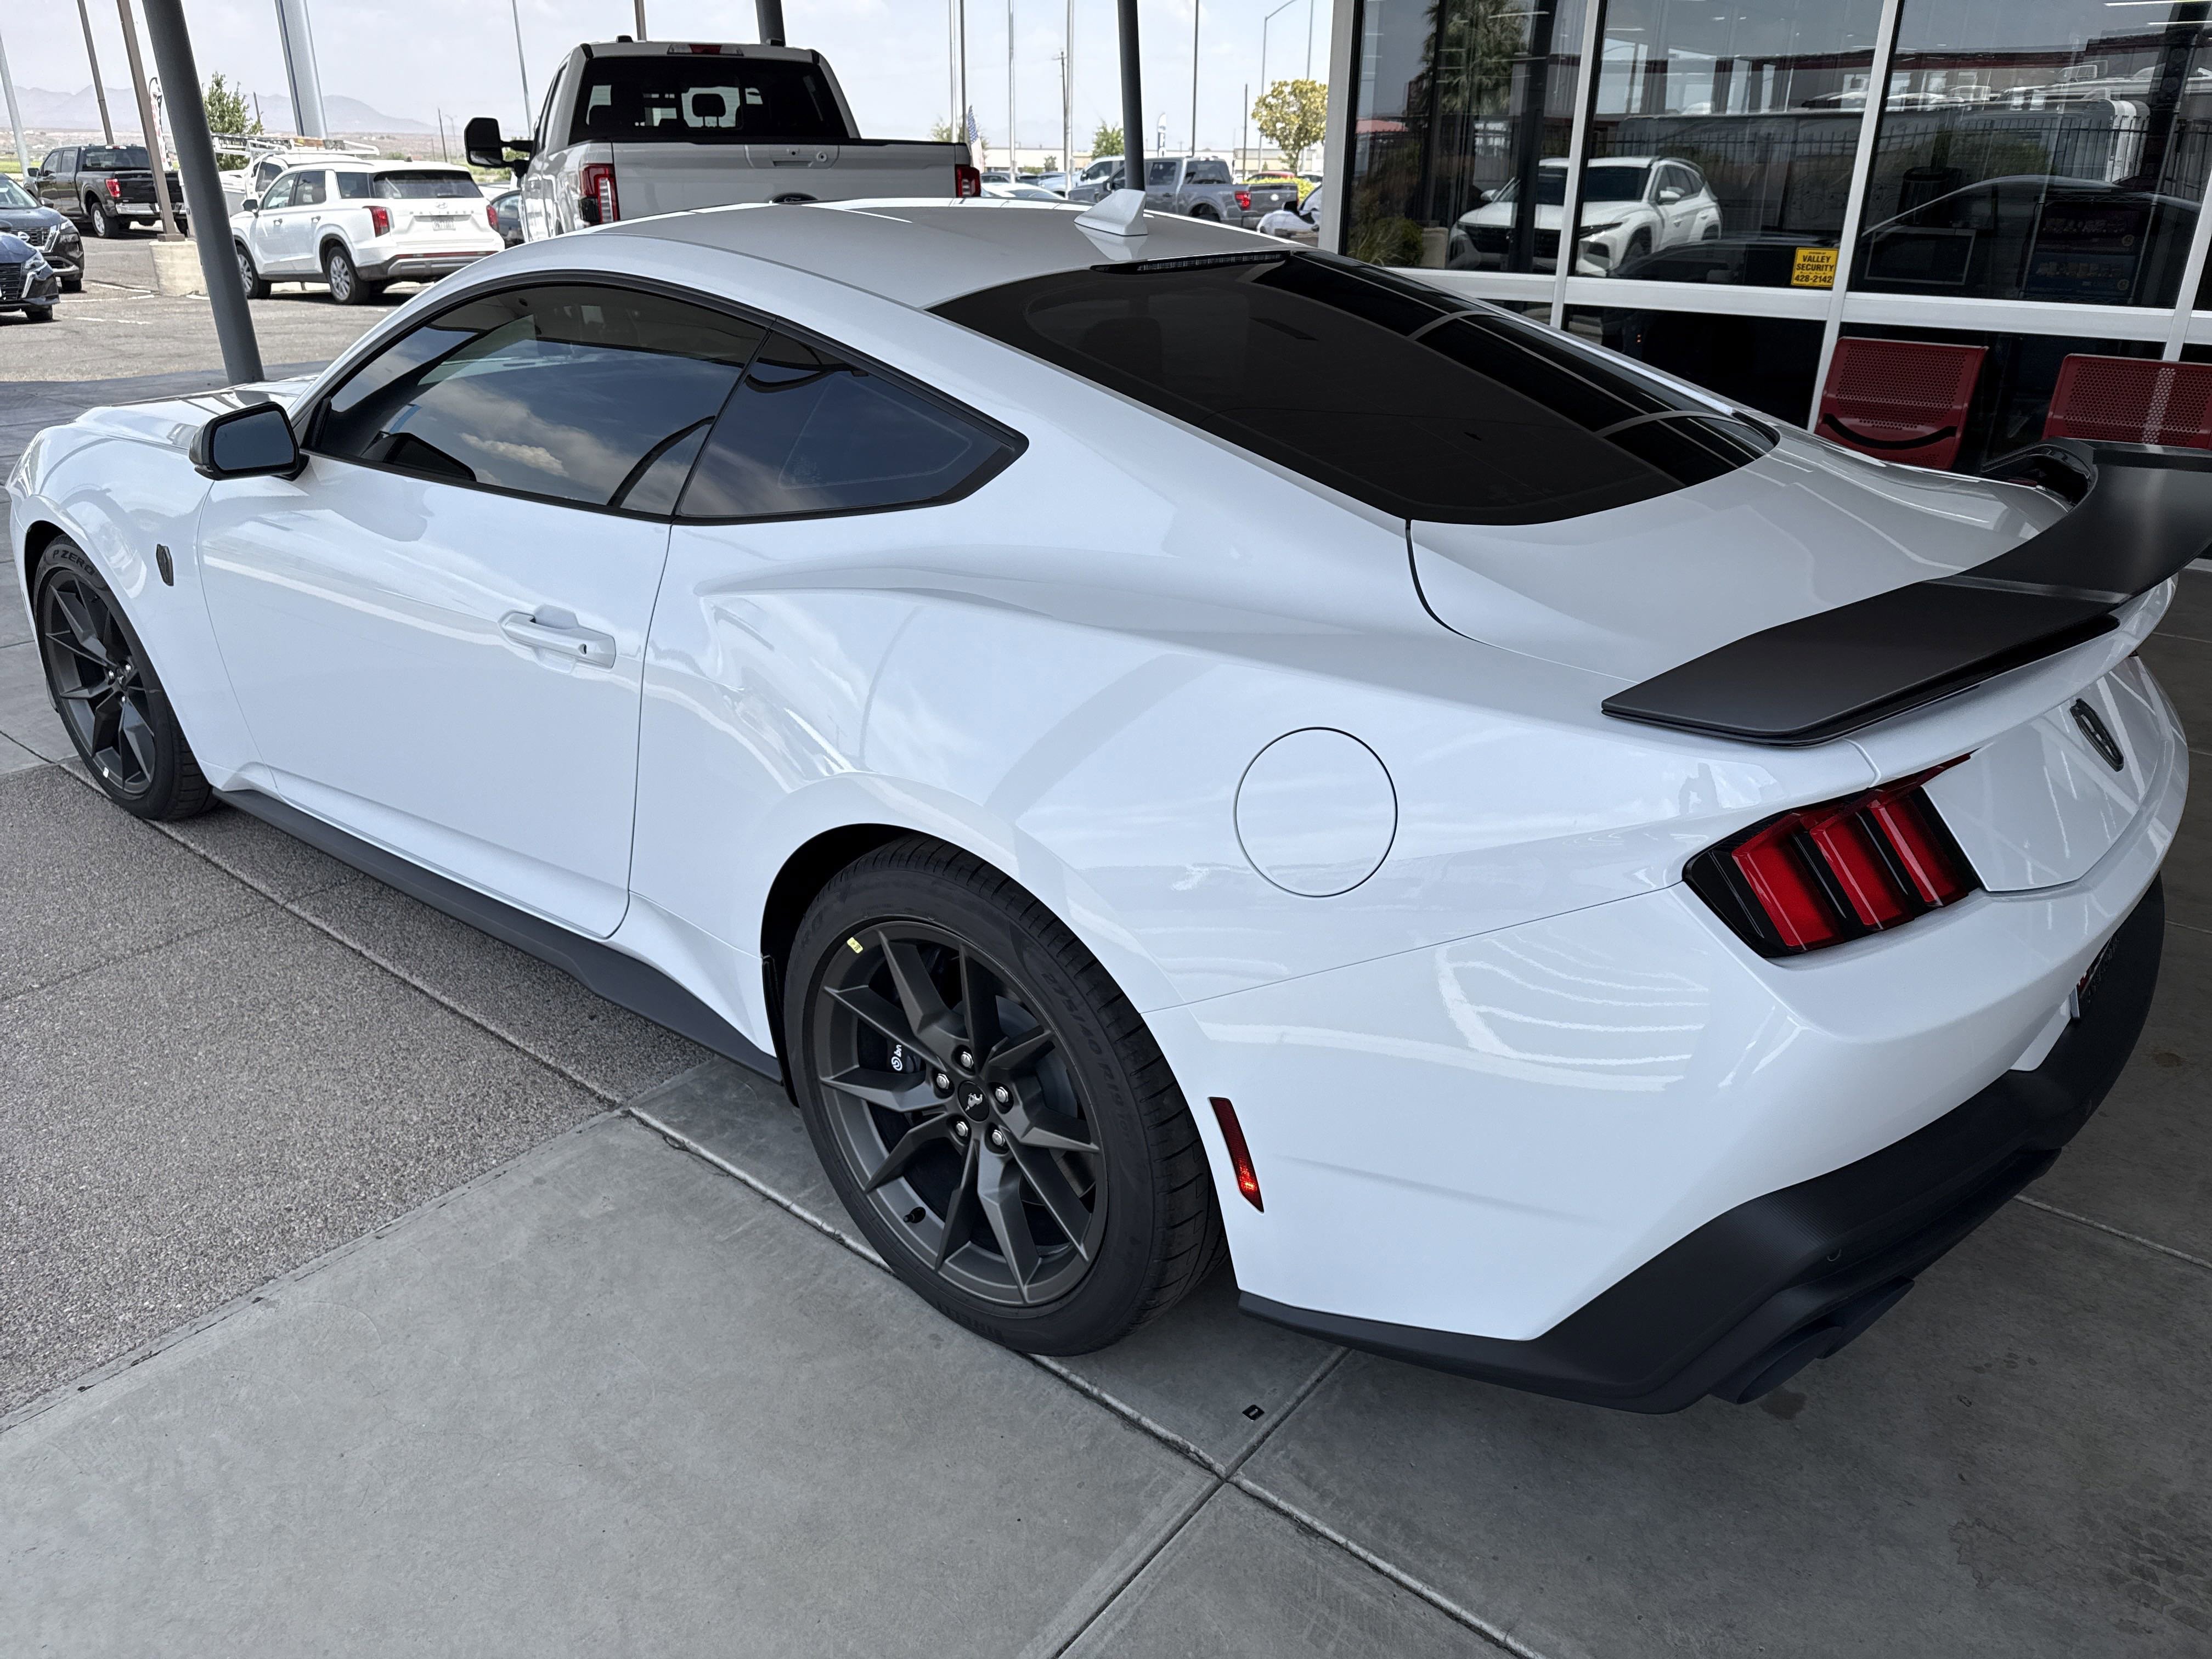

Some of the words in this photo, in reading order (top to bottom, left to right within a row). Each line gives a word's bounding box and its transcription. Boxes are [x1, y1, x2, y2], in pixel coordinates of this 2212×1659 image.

[1803, 255, 1831, 263] VALLEY
[1796, 263, 1834, 272] SECURITY
[1794, 275, 1833, 283] 428-2142
[60, 550, 96, 575] ZERO
